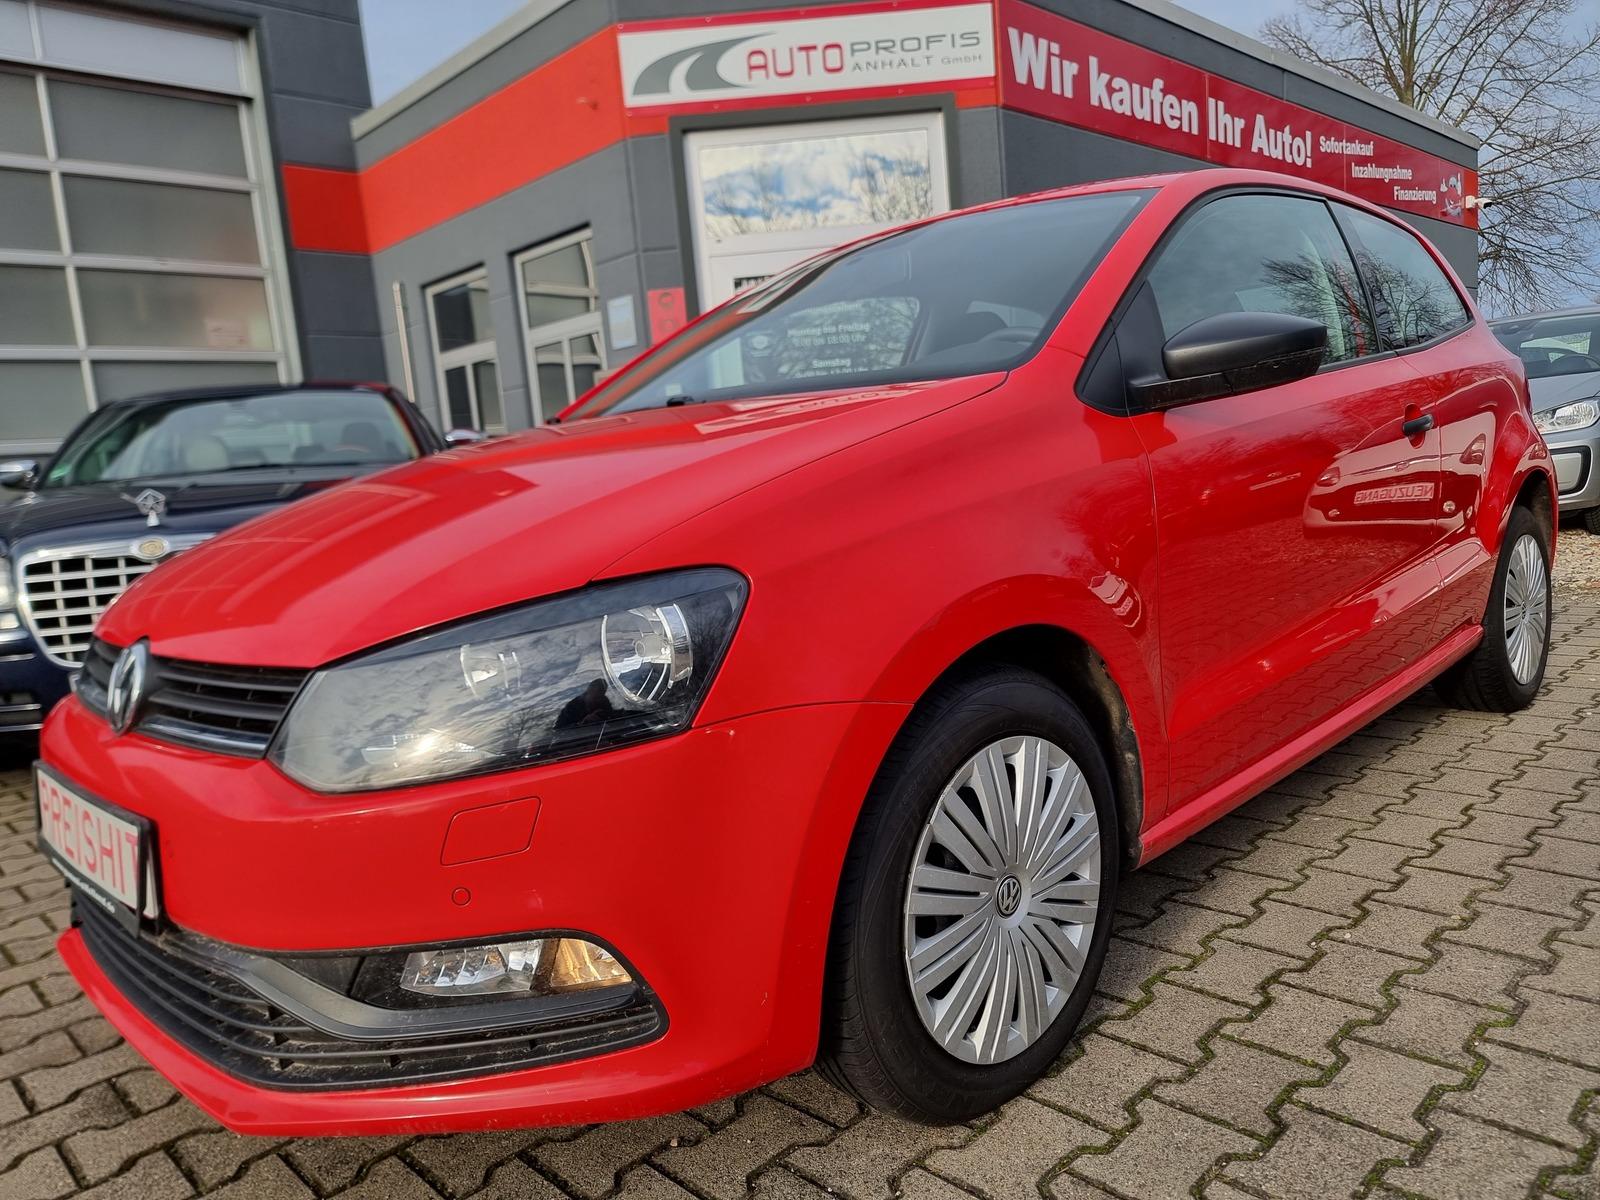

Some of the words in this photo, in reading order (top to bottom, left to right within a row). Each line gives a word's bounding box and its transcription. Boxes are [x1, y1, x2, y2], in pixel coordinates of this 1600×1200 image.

[746, 40, 845, 81] AUTO
[850, 31, 980, 57] PROFIS
[851, 56, 935, 72] ANHALT
[941, 54, 982, 65] GmbH
[1007, 27, 1079, 98] Wir
[1088, 55, 1199, 136] kaufen
[1207, 97, 1245, 148] Ihr
[1251, 113, 1312, 168] Auto!
[1319, 135, 1374, 156] Sofortankauf
[1351, 162, 1413, 183] Inzahlungnahme
[1393, 185, 1437, 204] Finanzierung
[40, 779, 139, 897] PREISHIT
